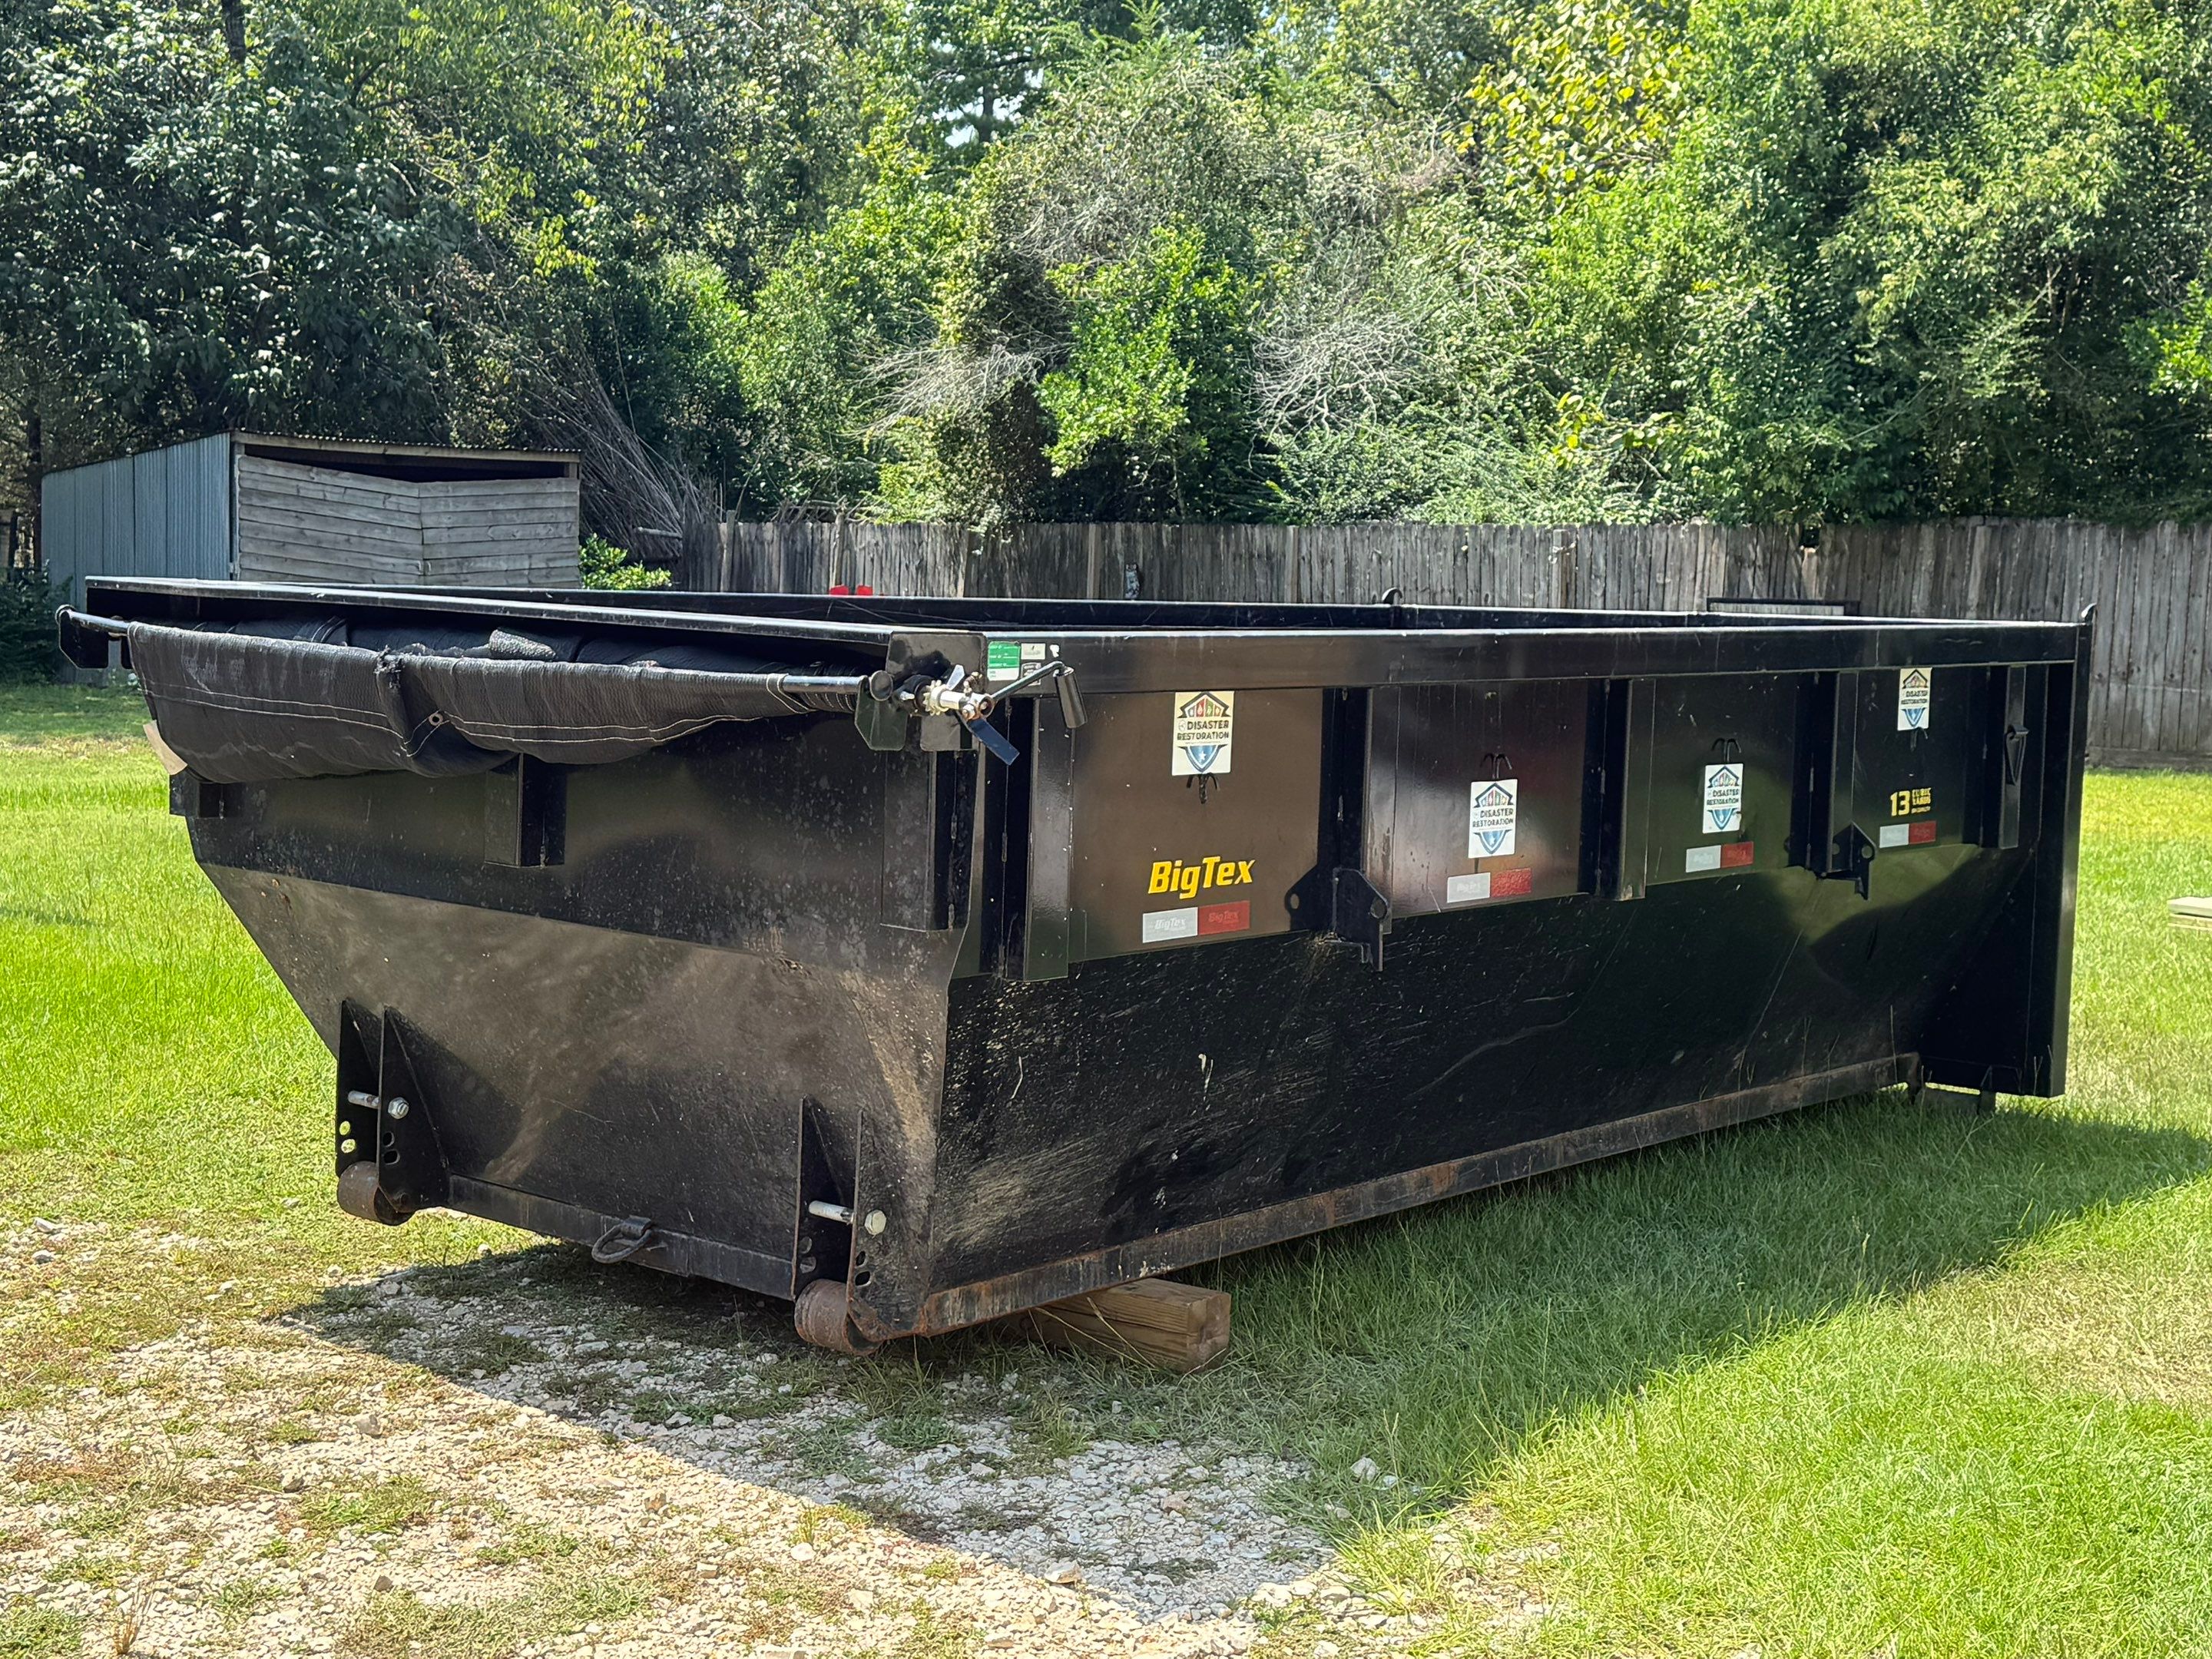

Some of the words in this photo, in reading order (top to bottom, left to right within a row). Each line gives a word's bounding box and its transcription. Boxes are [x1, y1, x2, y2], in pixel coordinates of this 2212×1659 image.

[1187, 720, 1229, 730] DISASTER
[1177, 731, 1229, 740] RESTORATION
[1890, 790, 1910, 816] 13
[1479, 807, 1514, 818] DISASTER
[1472, 818, 1514, 827] RESTORATION
[1147, 856, 1256, 899] BigTex
